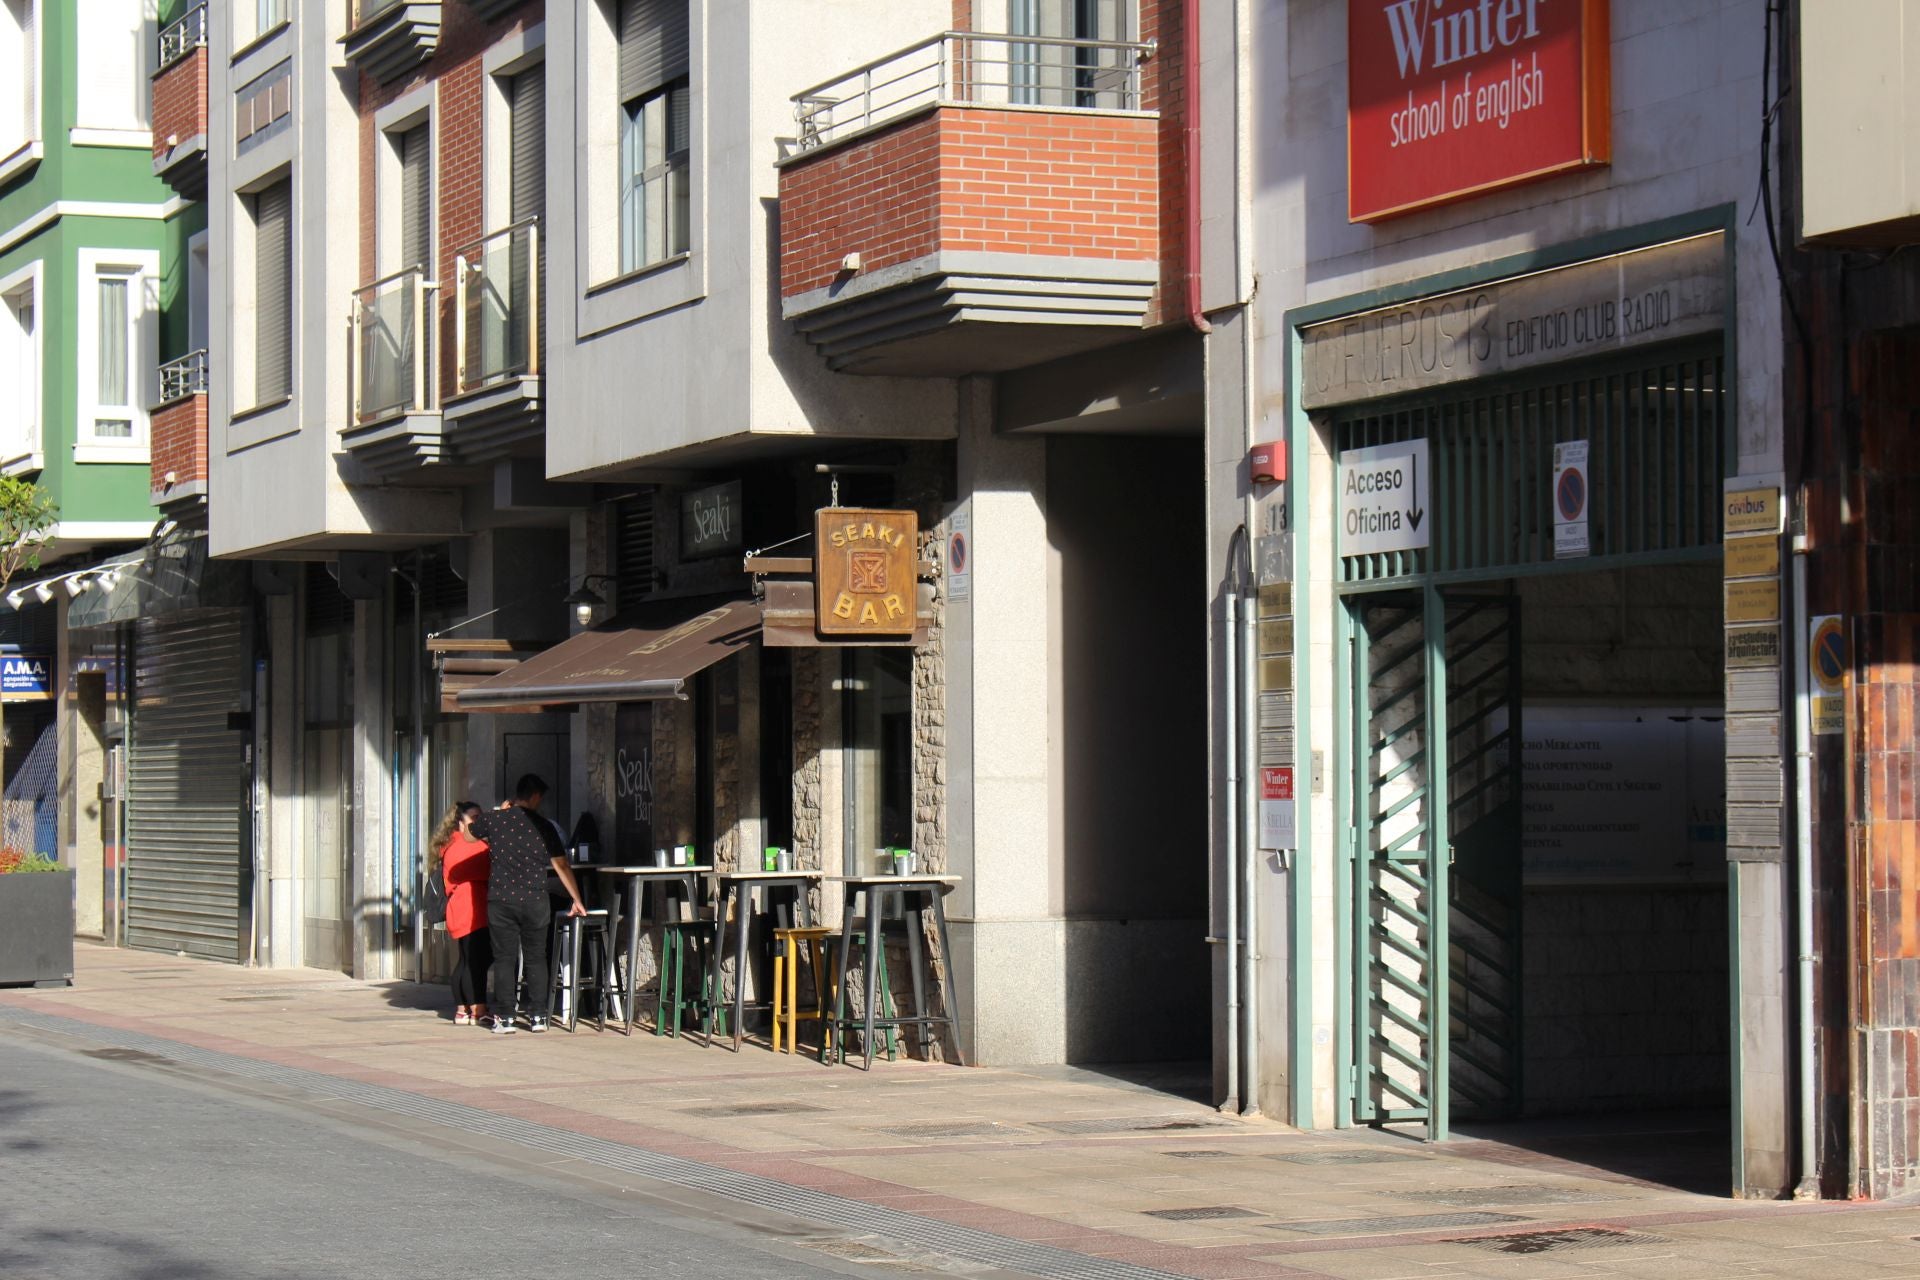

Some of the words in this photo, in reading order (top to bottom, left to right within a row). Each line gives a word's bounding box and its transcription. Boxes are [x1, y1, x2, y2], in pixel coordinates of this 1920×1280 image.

[1384, 0, 1543, 79] Winter
[1391, 90, 1446, 148] school
[1452, 72, 1472, 130] of
[1476, 51, 1543, 129] english
[1506, 311, 1568, 358] EDIFICIO
[1574, 301, 1616, 344] CLUB
[1622, 289, 1671, 335] RADIO
[1344, 303, 1456, 390] FUEROS
[1465, 294, 1491, 365] 13
[1346, 469, 1403, 496] Acceso
[693, 495, 730, 543] Seaki
[1270, 503, 1288, 532] 13
[1346, 505, 1401, 536] Oficina
[1728, 496, 1765, 516] civibus
[831, 522, 905, 548] SEAKI
[832, 592, 905, 624] BAR
[4, 661, 46, 674] A.M.A.
[618, 747, 653, 799] Seak
[1266, 770, 1288, 785] Winter
